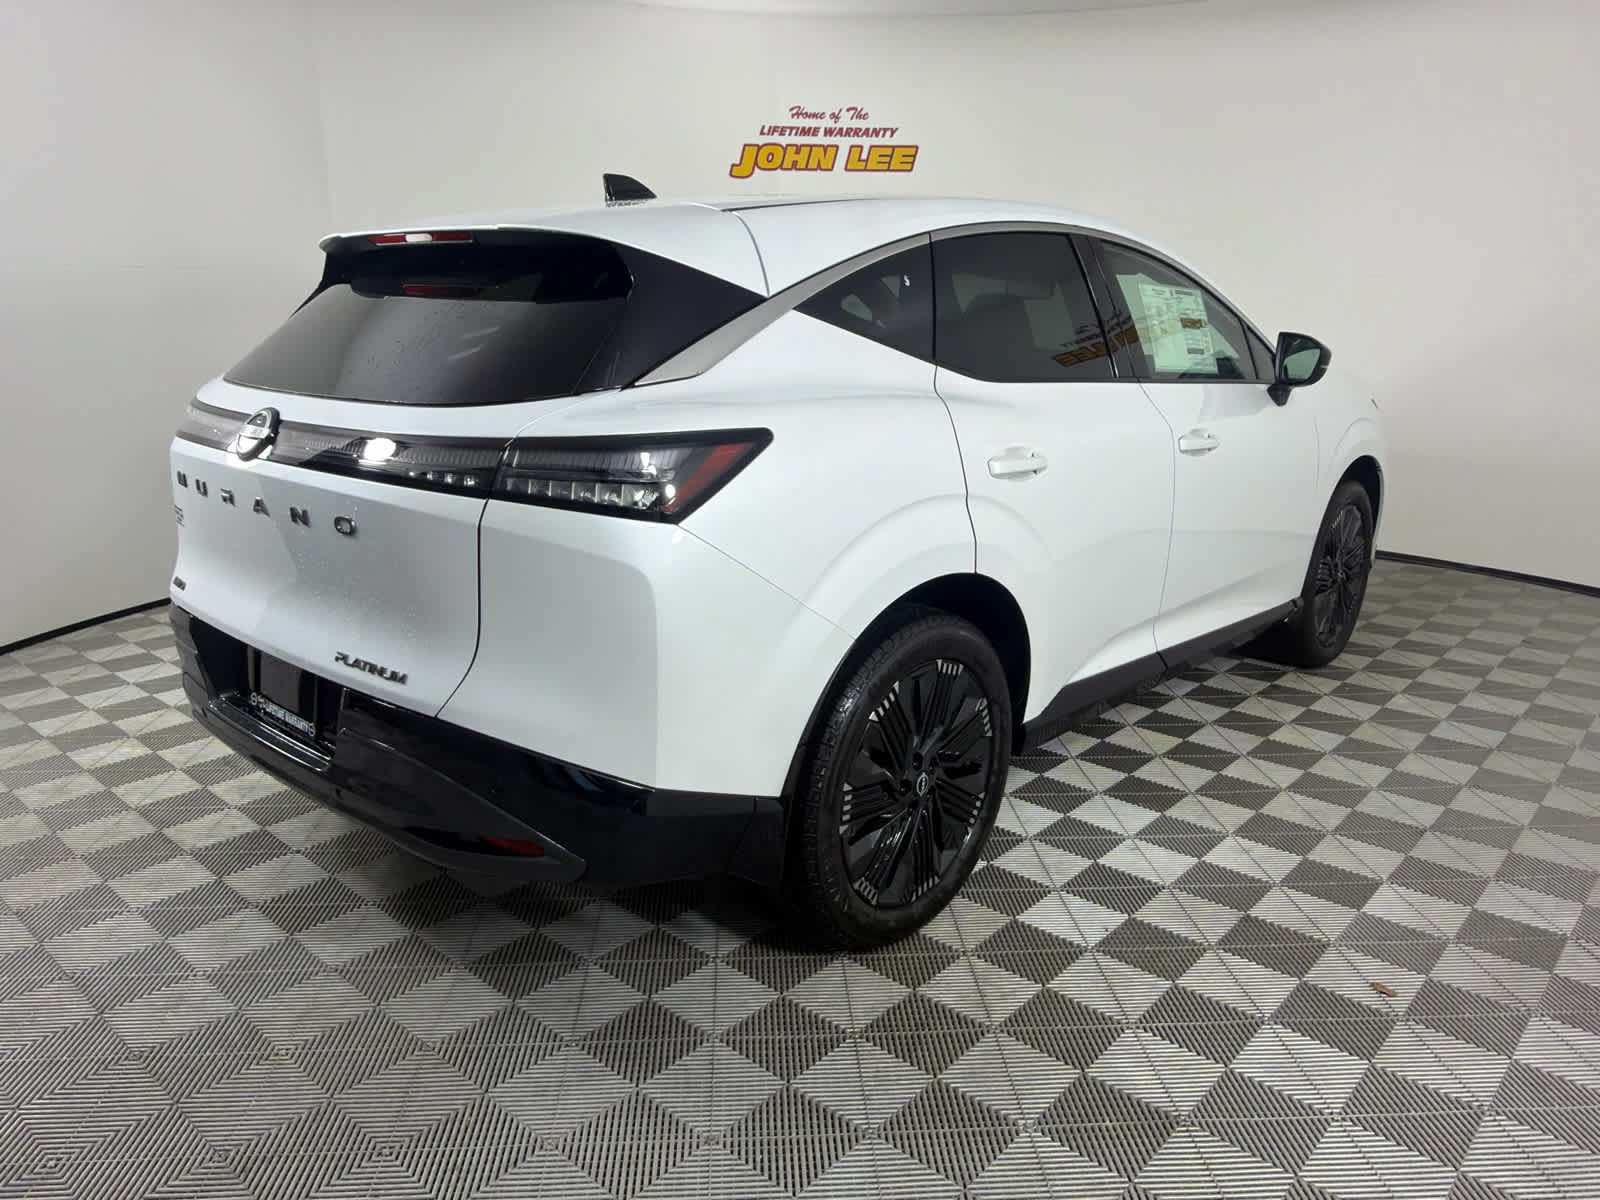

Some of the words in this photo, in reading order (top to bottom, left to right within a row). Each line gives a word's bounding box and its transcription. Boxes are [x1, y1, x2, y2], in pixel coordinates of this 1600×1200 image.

[789, 105, 826, 120] Home
[829, 107, 843, 124] of
[846, 106, 869, 121] The
[759, 125, 821, 137] LIFETIME
[823, 127, 899, 138] WARRANTY
[729, 142, 839, 179] JOHN
[844, 144, 919, 172] LEE
[334, 651, 408, 685] PLATINUM
